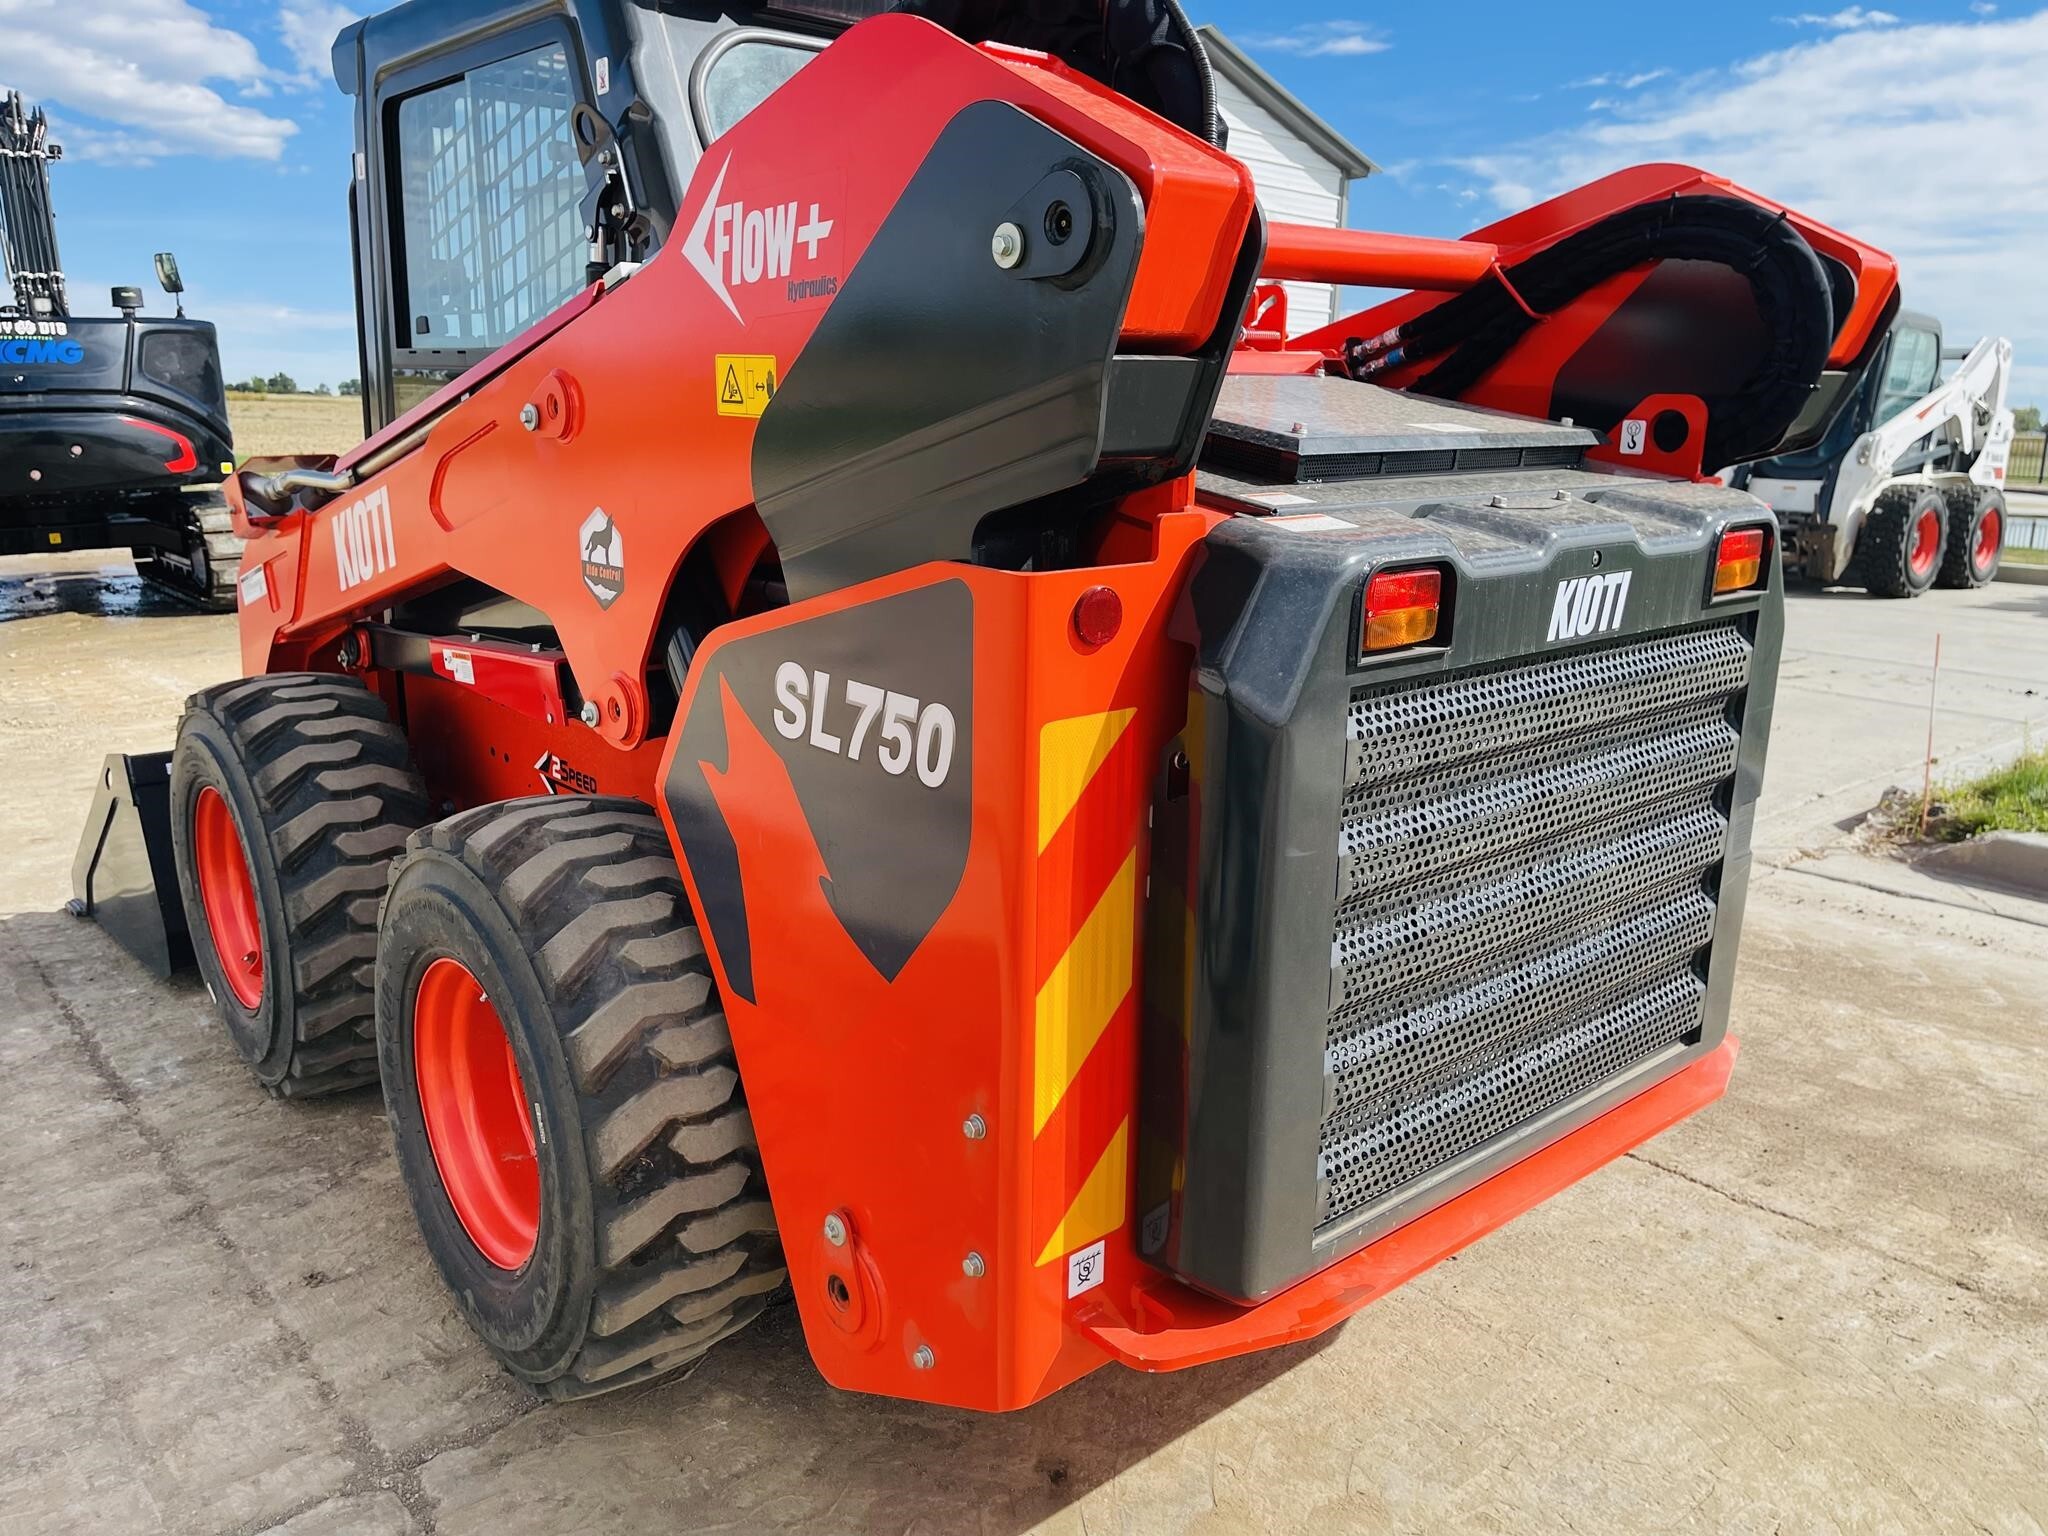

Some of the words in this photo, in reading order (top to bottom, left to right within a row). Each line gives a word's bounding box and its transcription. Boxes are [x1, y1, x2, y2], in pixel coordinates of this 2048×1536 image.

[787, 275, 838, 303] Hydraulics
[332, 485, 396, 592] KIOTI
[1546, 570, 1632, 642] KIOTI
[773, 661, 956, 789] SL750
